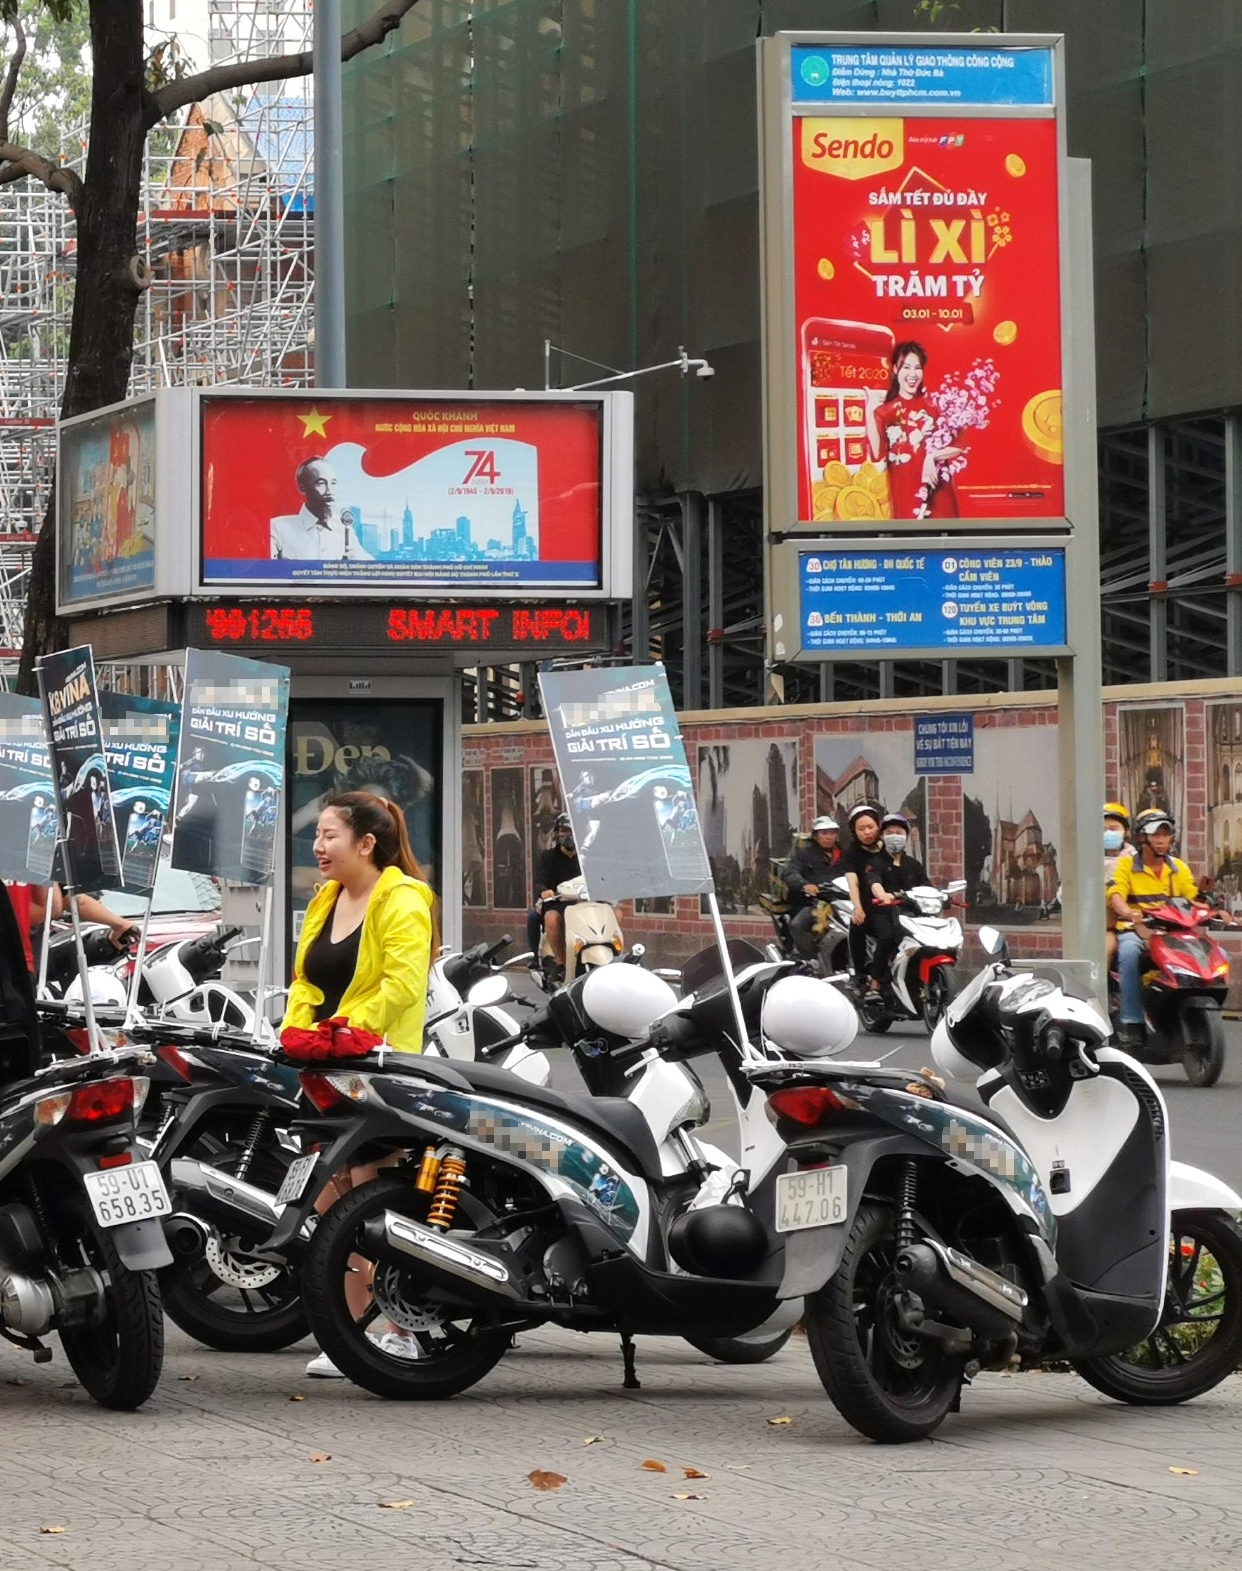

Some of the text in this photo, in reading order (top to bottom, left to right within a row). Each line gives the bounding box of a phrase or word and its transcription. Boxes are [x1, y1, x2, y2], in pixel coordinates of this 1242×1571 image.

[831, 54, 859, 66] TRUNG
[860, 52, 878, 65] TÂM
[903, 53, 915, 66] LÝ
[916, 55, 936, 66] GIAO
[937, 54, 964, 67] THÔNG
[966, 54, 989, 67] CÔNG
[811, 132, 894, 159] Sendo
[869, 186, 988, 206] SẮM TẾT ĐỦ ĐẦY
[870, 208, 986, 264] LÌ XÌ
[872, 268, 986, 297] TRĂM TỶ
[903, 309, 930, 319] 03.01
[939, 308, 963, 319] 10.01
[858, 366, 889, 380] 2020
[461, 450, 501, 485] 74
[809, 561, 820, 571] 30
[959, 557, 981, 569] CÔNG
[824, 611, 843, 624] BẾN
[845, 611, 877, 623] THÀNH
[909, 612, 922, 622] AN
[944, 605, 958, 614] 120
[959, 601, 986, 612] TUYẾN
[988, 603, 1000, 612] XE
[1002, 601, 1023, 612] BUÝT
[387, 608, 499, 641] SMART
[959, 616, 977, 626] KHU
[997, 615, 1025, 625] TRUNG
[1027, 613, 1046, 624] TÂM
[79, 713, 96, 738] SỐ
[222, 709, 234, 718] XU
[235, 709, 276, 723] HƯỚNG
[190, 716, 276, 746] GIẢI TRÍ SỐ
[565, 716, 665, 739] DẪN ĐẦU XU HƯỚNG
[125, 742, 167, 754] HƯỚNG
[567, 726, 671, 753] GIẢI TRÍ SỐ
[6, 749, 30, 763] TRÍ
[133, 752, 166, 774] SỐ
[97, 1167, 149, 1197] 59-U1
[788, 1171, 833, 1200] 59-H1
[99, 1189, 165, 1221] 658.35
[781, 1196, 841, 1227] 447.06
